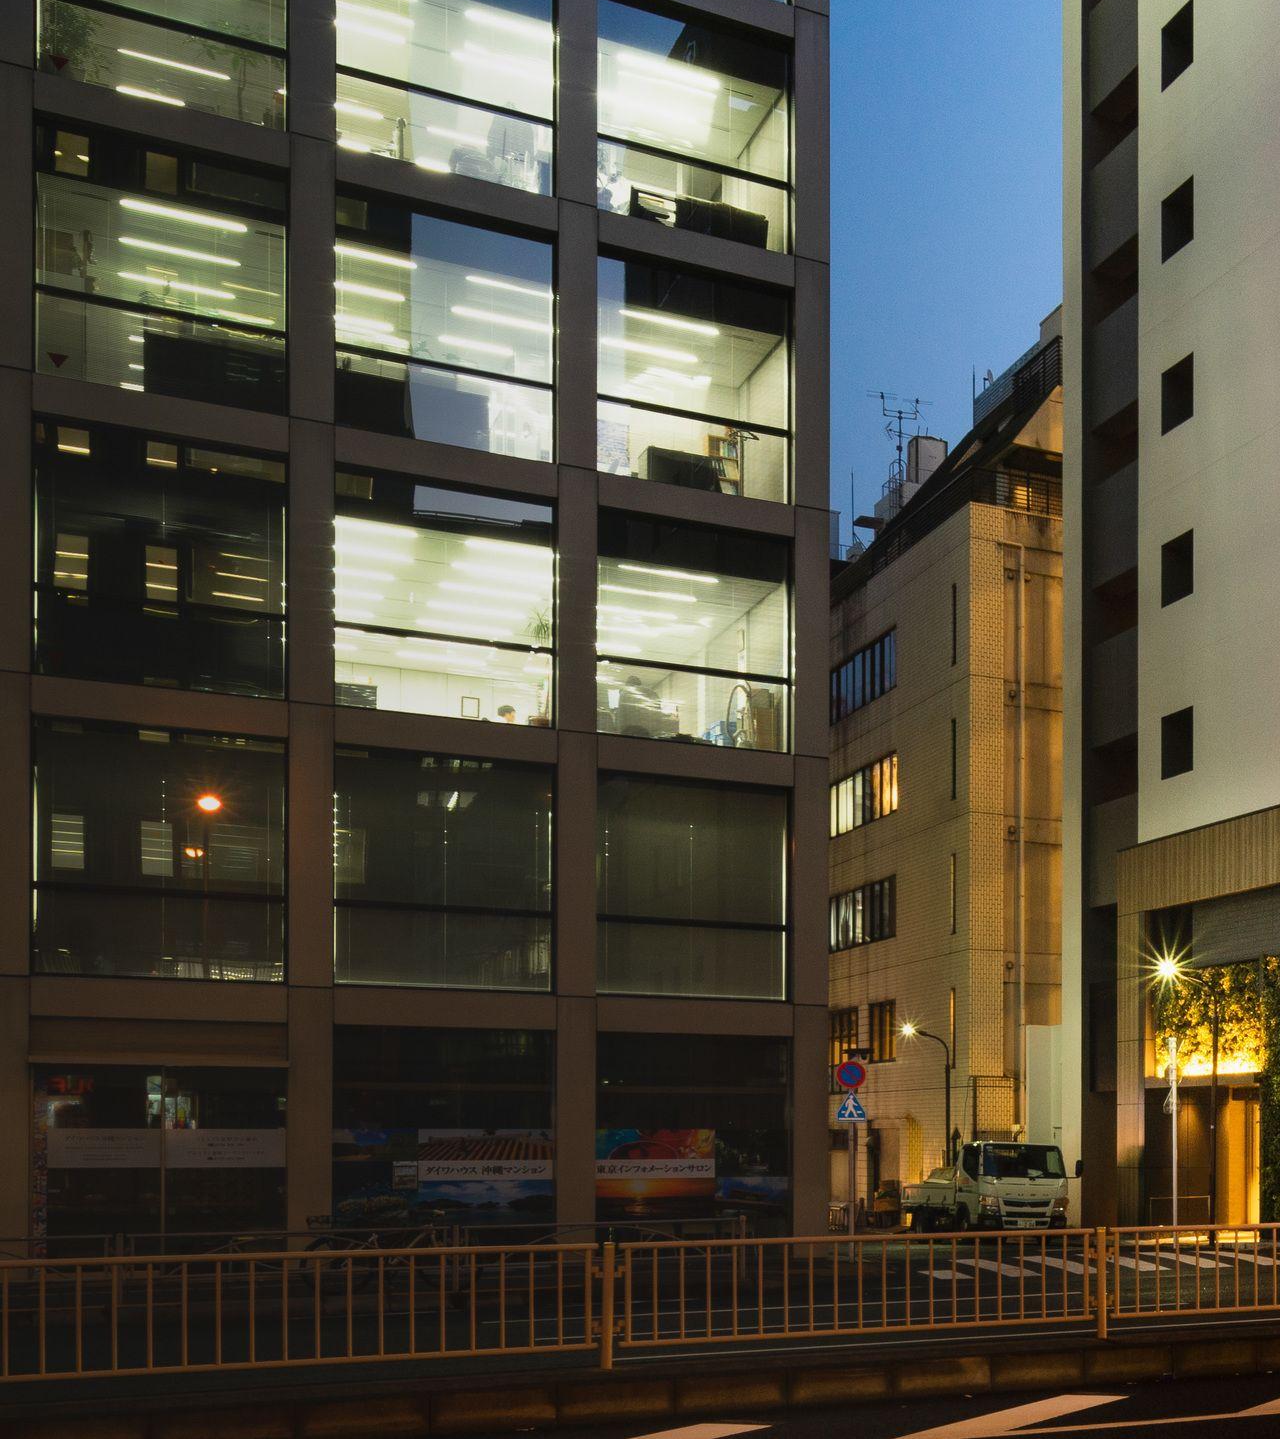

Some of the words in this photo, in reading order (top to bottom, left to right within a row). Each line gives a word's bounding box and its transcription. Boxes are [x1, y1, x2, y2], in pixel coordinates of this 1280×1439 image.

[425, 1165, 478, 1176] ダイワハウス
[481, 1165, 547, 1176] 沖縄マンション
[596, 1163, 712, 1175] 東京インフォメーションサロン
